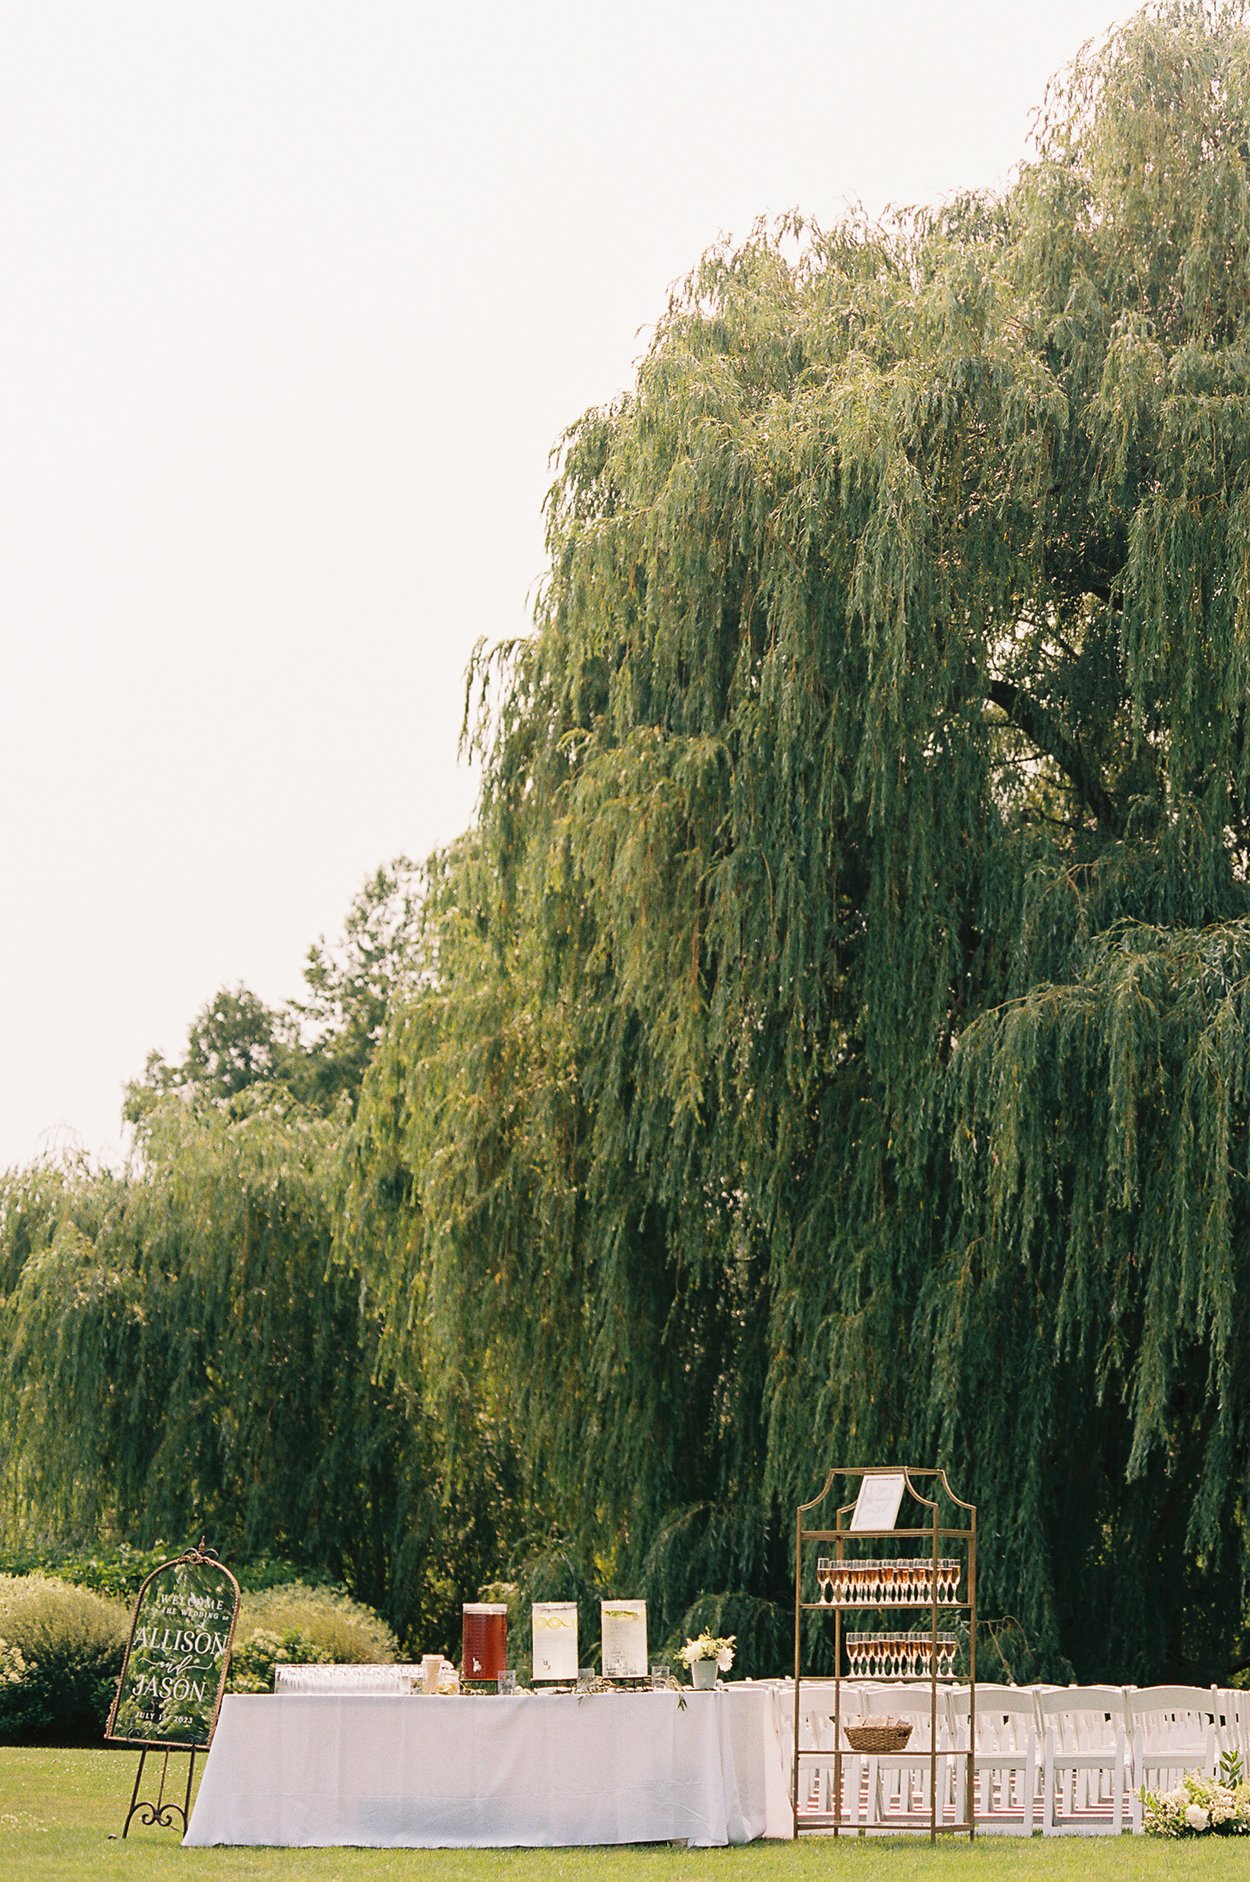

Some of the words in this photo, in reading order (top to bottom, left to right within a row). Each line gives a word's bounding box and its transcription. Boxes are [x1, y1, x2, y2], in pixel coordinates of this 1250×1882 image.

[161, 1594, 224, 1610] WELCOME
[181, 1609, 219, 1620] WEDDING
[132, 1626, 230, 1655] ALLISON
[138, 1655, 212, 1676] and
[132, 1675, 207, 1702] JASON
[136, 1711, 155, 1720] JULY
[174, 1716, 193, 1724] 2023
